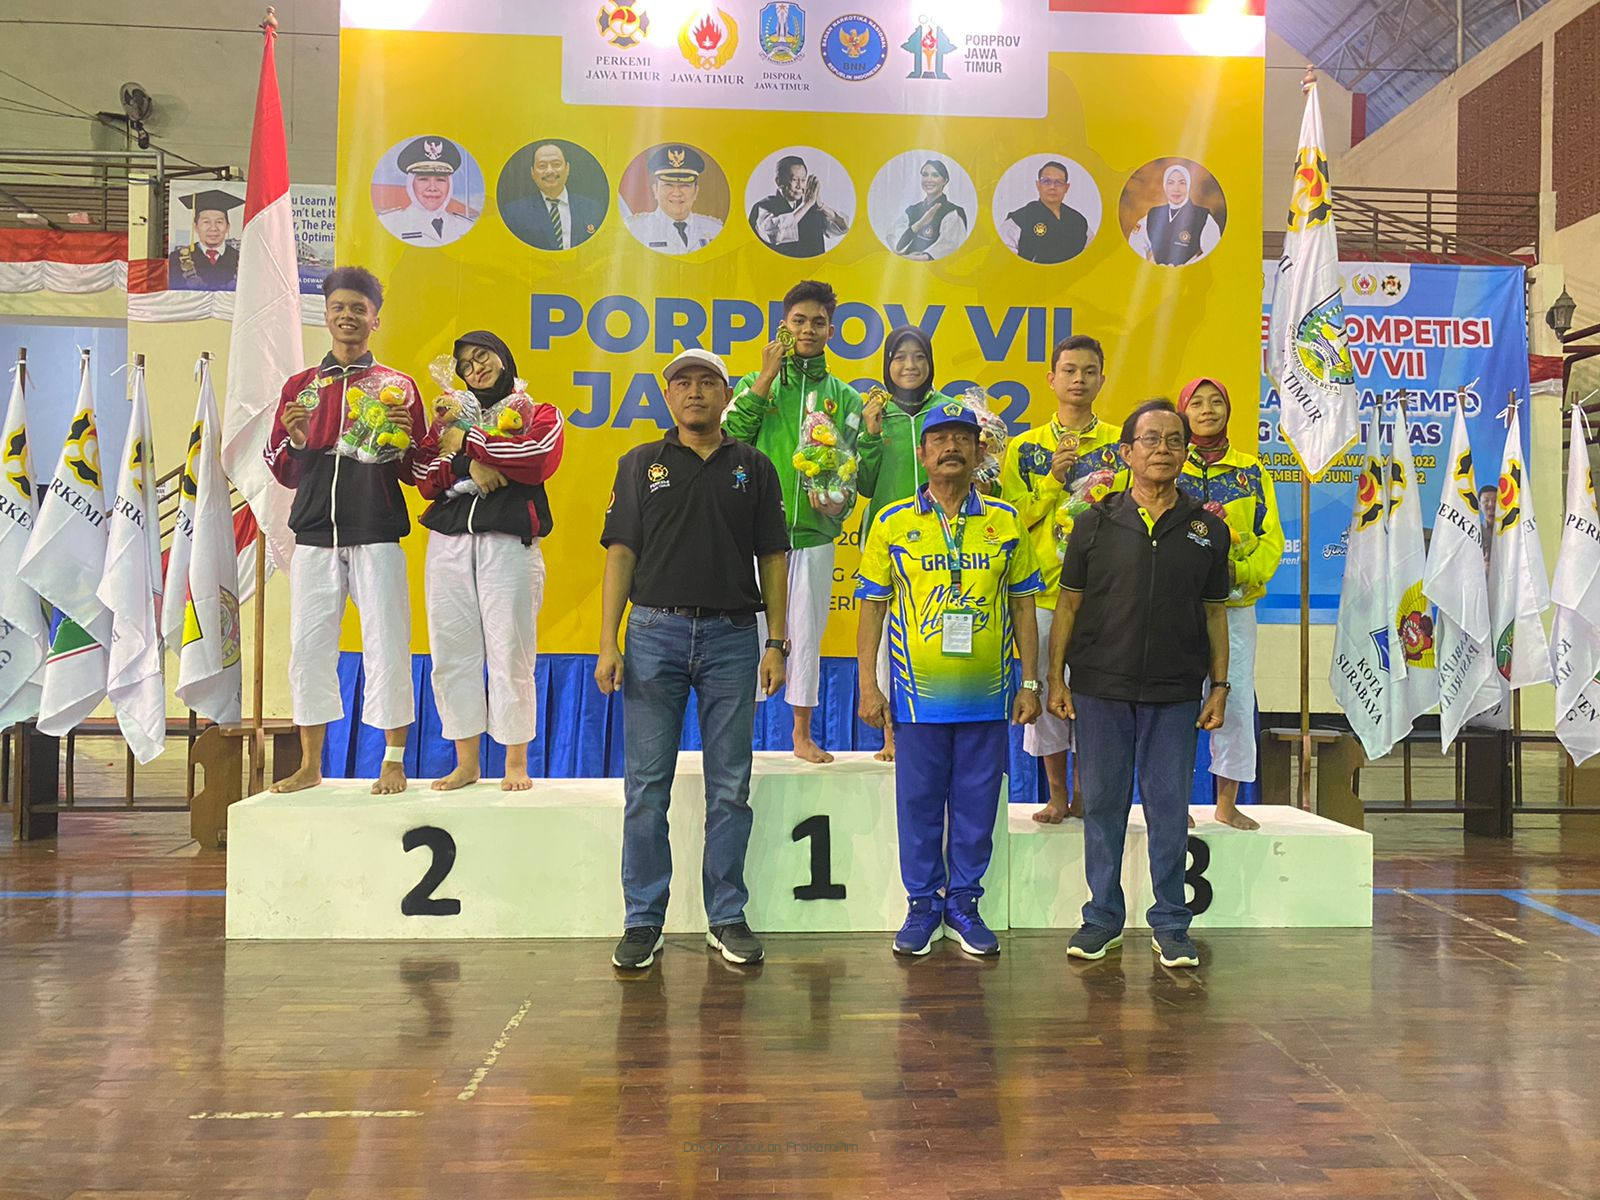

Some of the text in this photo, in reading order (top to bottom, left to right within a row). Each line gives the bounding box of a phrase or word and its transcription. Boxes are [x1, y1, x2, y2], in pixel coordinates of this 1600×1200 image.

[965, 34, 1021, 48] PORPROV
[964, 48, 998, 60] JAWA
[595, 56, 651, 67] PERKEMI
[843, 62, 866, 71] BNN
[964, 61, 1002, 73] TIMUR
[585, 70, 661, 82] JAWA TIMUR
[670, 73, 745, 85] JAWA TIMUR
[762, 72, 802, 81] DISPORA
[753, 82, 810, 92] JAWA TIMUR
[300, 196, 326, 206] Learn
[312, 209, 326, 218] Let
[301, 220, 318, 230] The
[302, 232, 336, 243] Optimi
[530, 293, 1072, 363] PORPOV VII
[1345, 317, 1491, 345] OMPETISI
[1382, 351, 1425, 378] VII
[1283, 371, 1322, 424] TIMUR
[1326, 471, 1352, 483] JUNI
[50, 478, 104, 528] RKEMI
[921, 582, 990, 617] Mke
[1357, 657, 1384, 698] KOTA
[1336, 653, 1383, 725] SURABAYA
[792, 815, 846, 901] 1
[401, 825, 461, 916] 2
